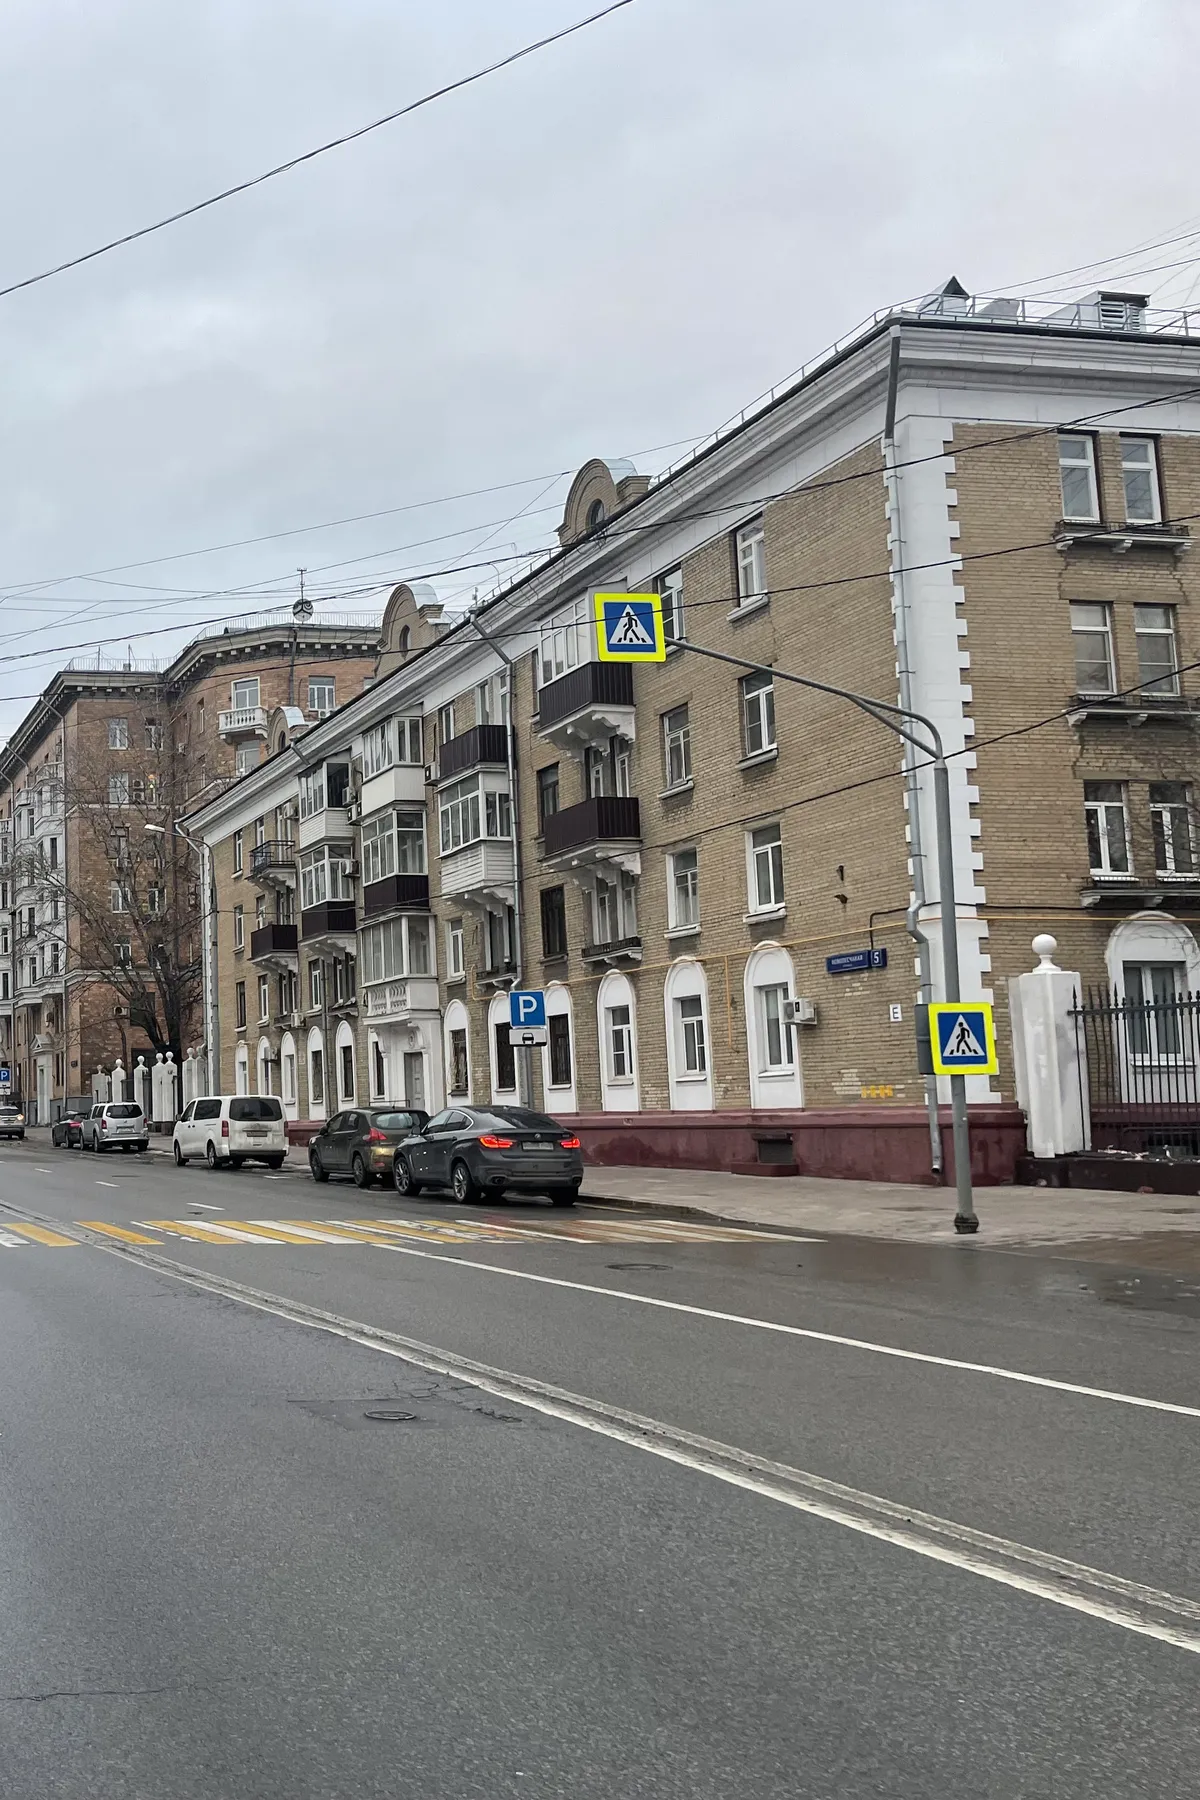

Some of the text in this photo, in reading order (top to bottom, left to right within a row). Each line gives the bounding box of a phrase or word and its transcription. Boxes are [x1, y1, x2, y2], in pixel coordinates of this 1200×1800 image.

[873, 951, 880, 964] 5
[518, 995, 538, 1022] P
[0, 1070, 8, 1081] P
